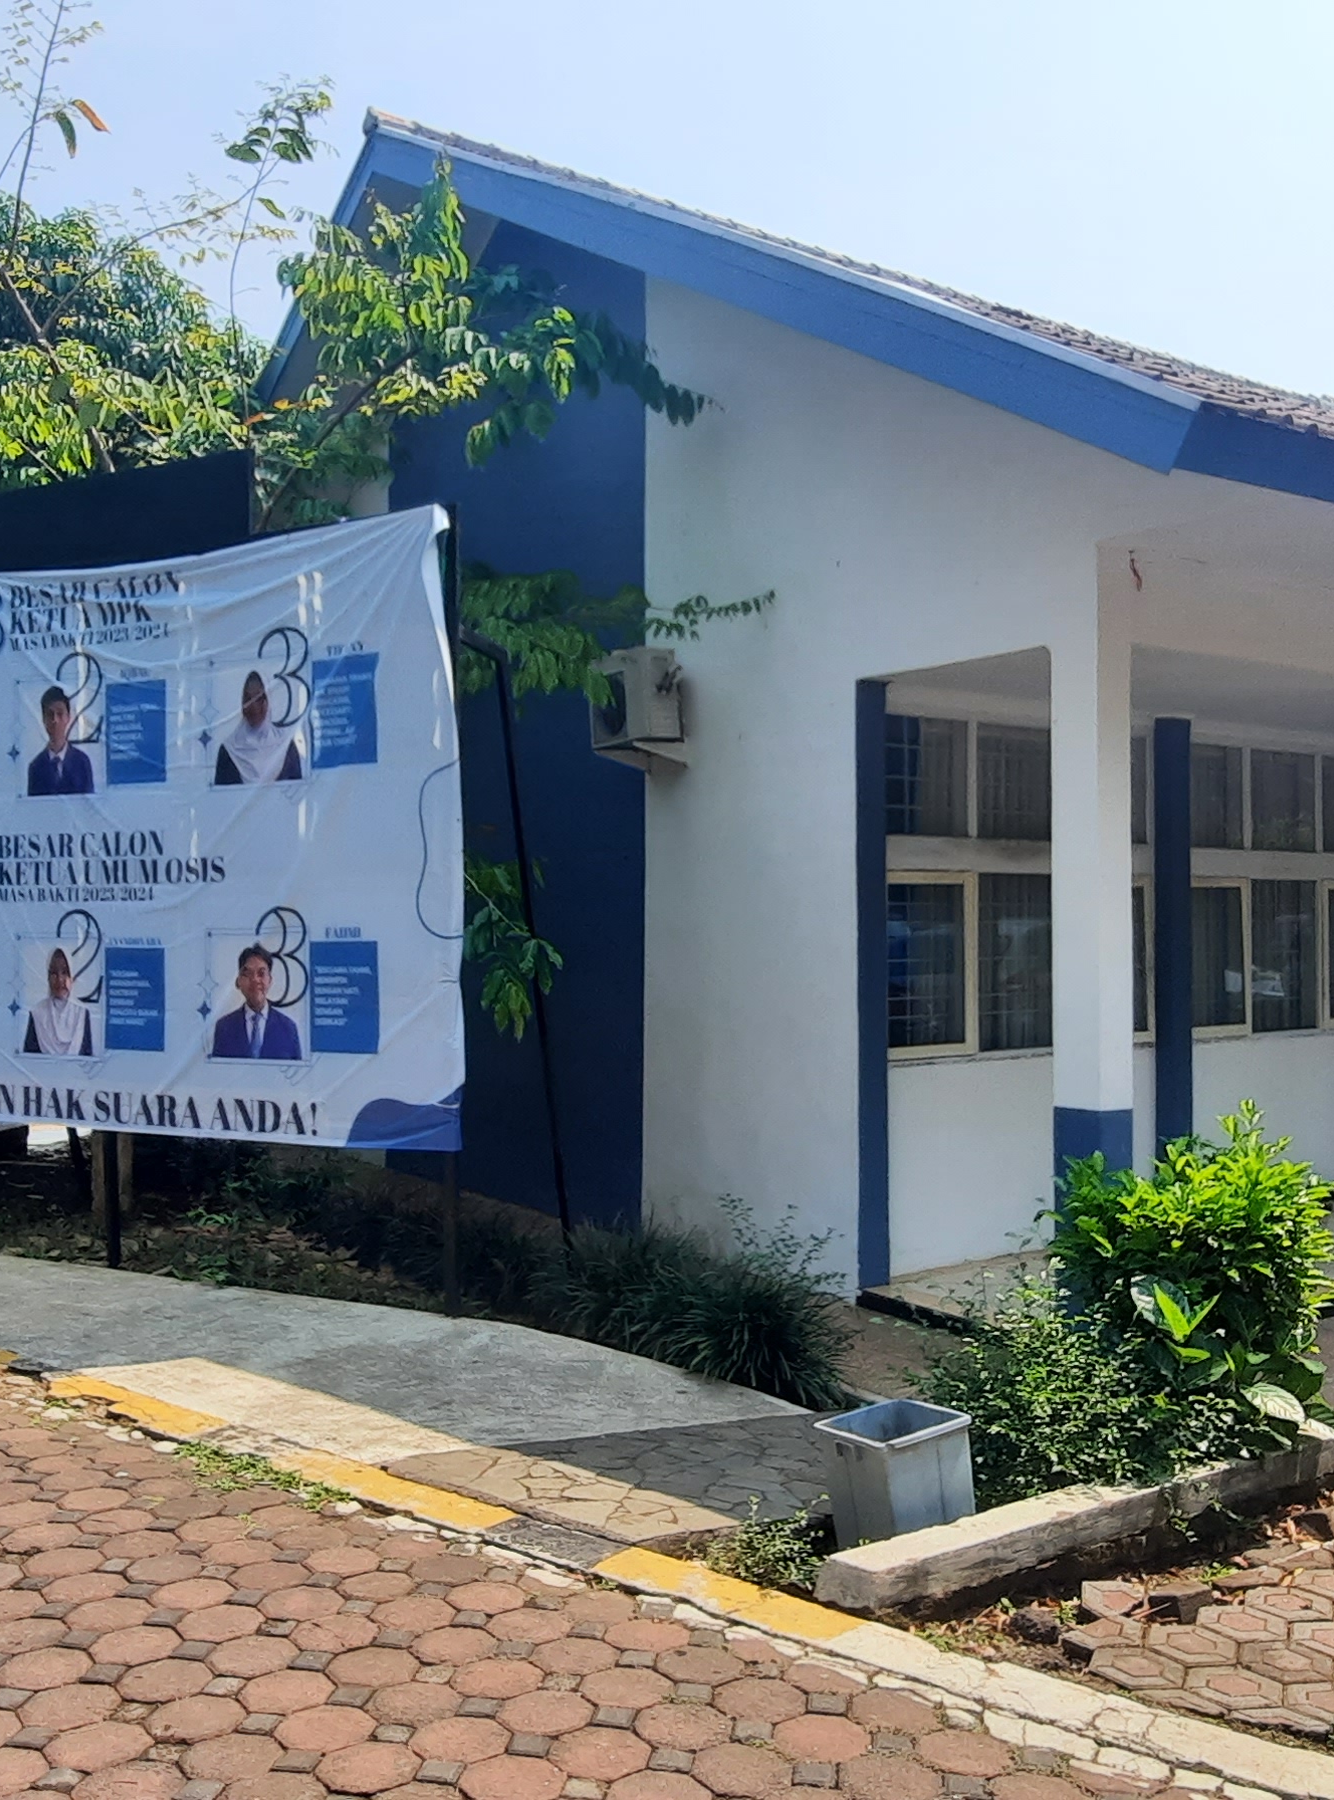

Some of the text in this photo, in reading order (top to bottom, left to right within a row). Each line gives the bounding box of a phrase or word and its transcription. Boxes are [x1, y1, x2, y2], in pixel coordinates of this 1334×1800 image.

[10, 571, 180, 609] BESAR CALON
[9, 600, 152, 635] KETUA MPK
[56, 651, 103, 744] 2
[258, 627, 311, 728] 3
[79, 830, 165, 858] CALON
[82, 858, 160, 886] UMUM
[164, 856, 227, 884] OSIS
[36, 887, 80, 902] BAKTI
[56, 908, 104, 1003] 2
[255, 906, 308, 1007] 3
[23, 1085, 86, 1121] HAK
[93, 1091, 202, 1130] SUARA
[202, 1098, 318, 1138] ANDA!
